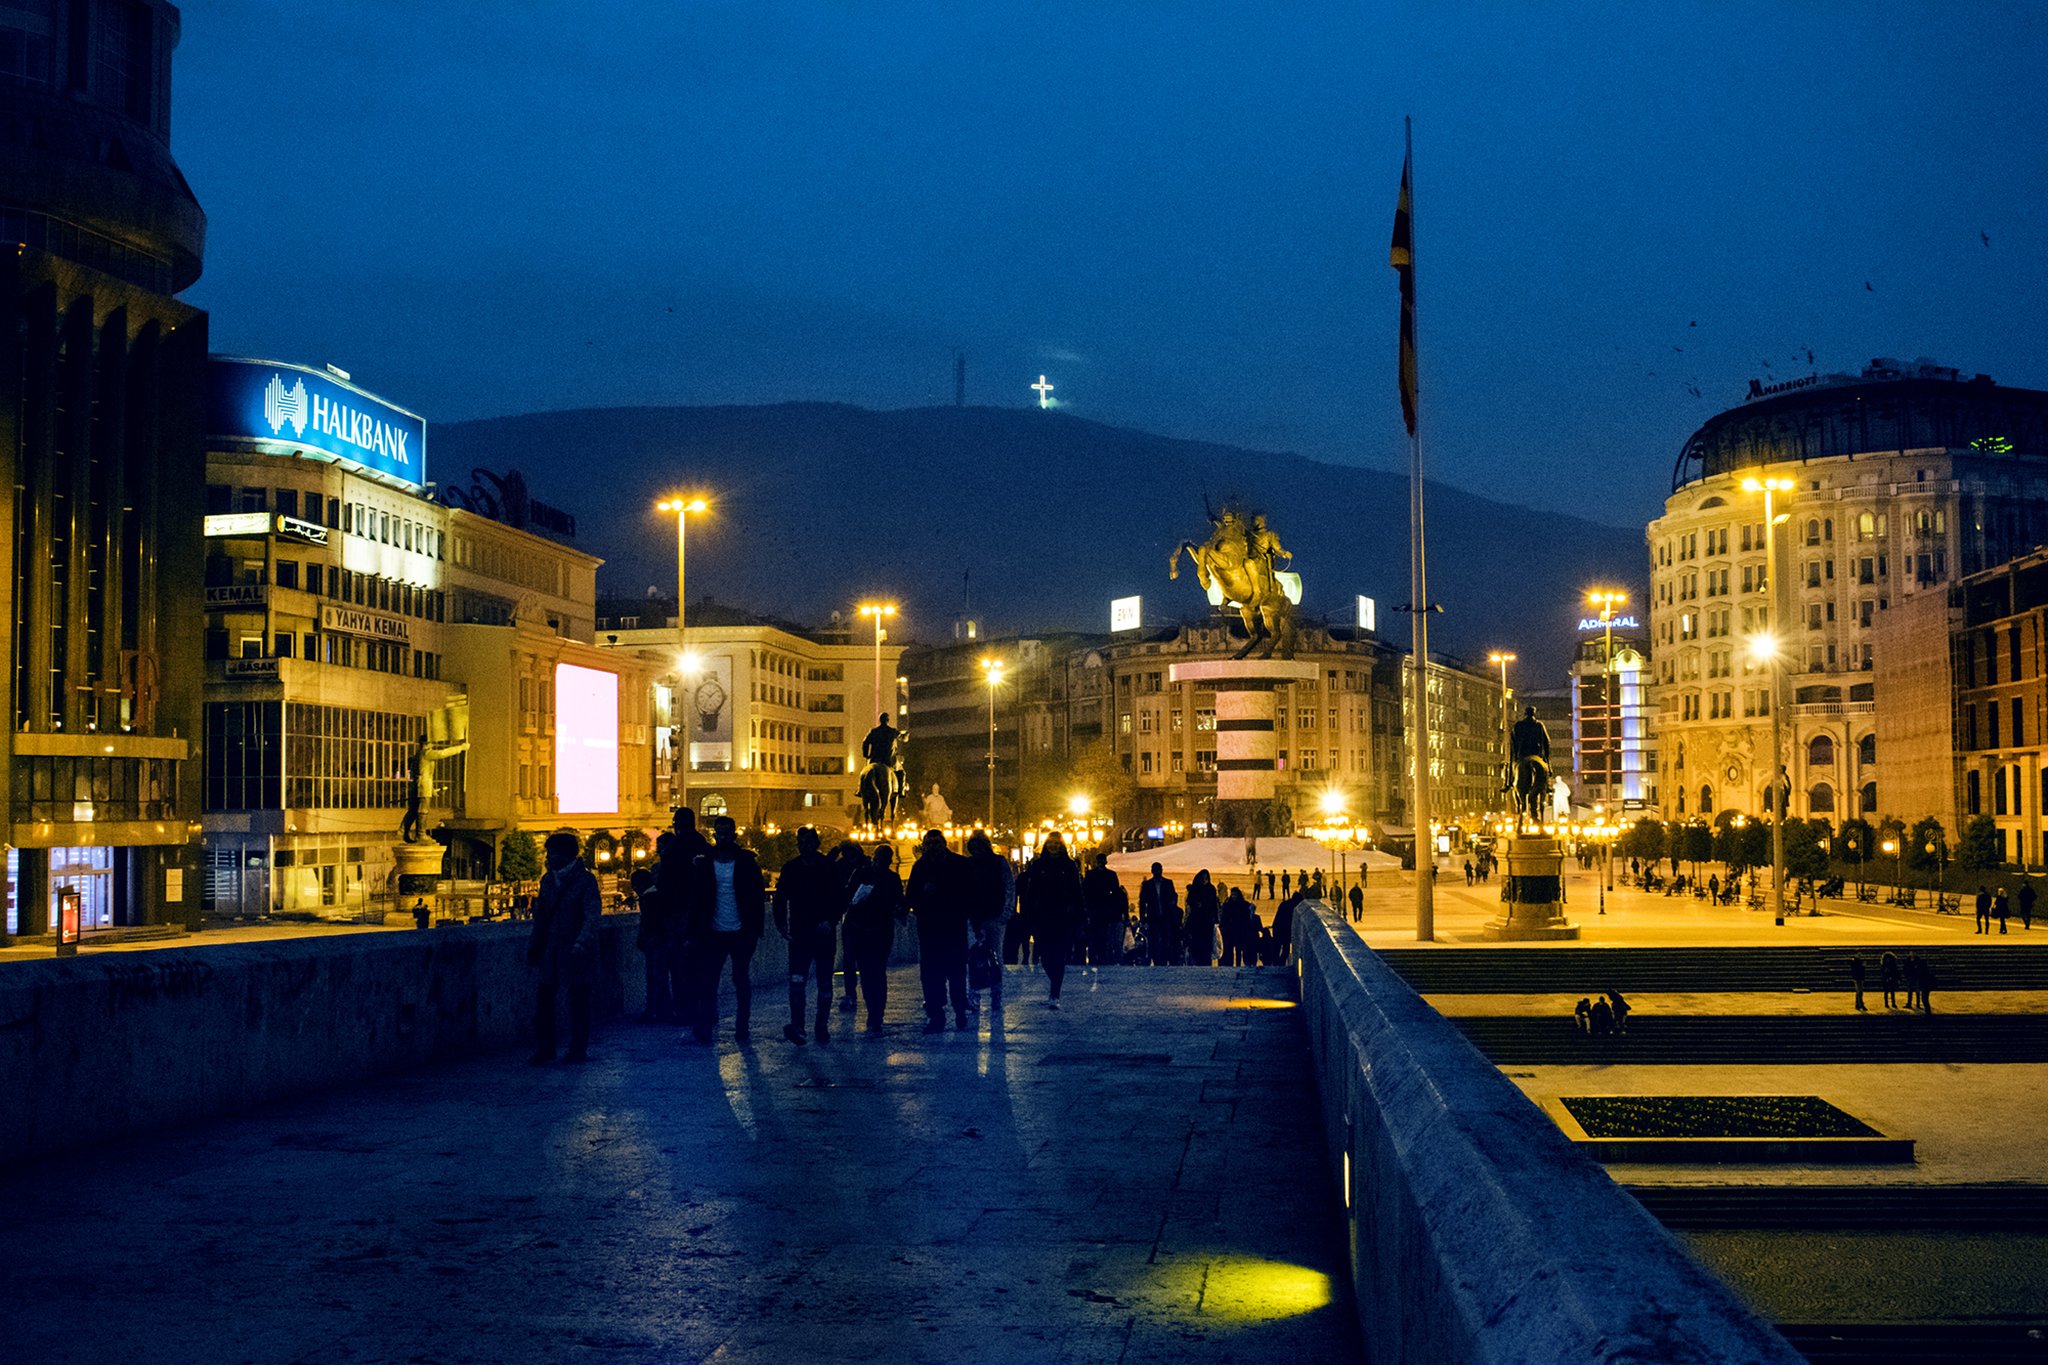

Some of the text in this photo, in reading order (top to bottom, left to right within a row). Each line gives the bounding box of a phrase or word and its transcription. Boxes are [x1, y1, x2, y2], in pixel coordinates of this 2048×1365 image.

[1764, 376, 1817, 394] MARRIOTT
[313, 393, 409, 465] HALKBANK
[207, 586, 263, 601] KEMAL
[336, 609, 409, 639] YAHYA KEMAL
